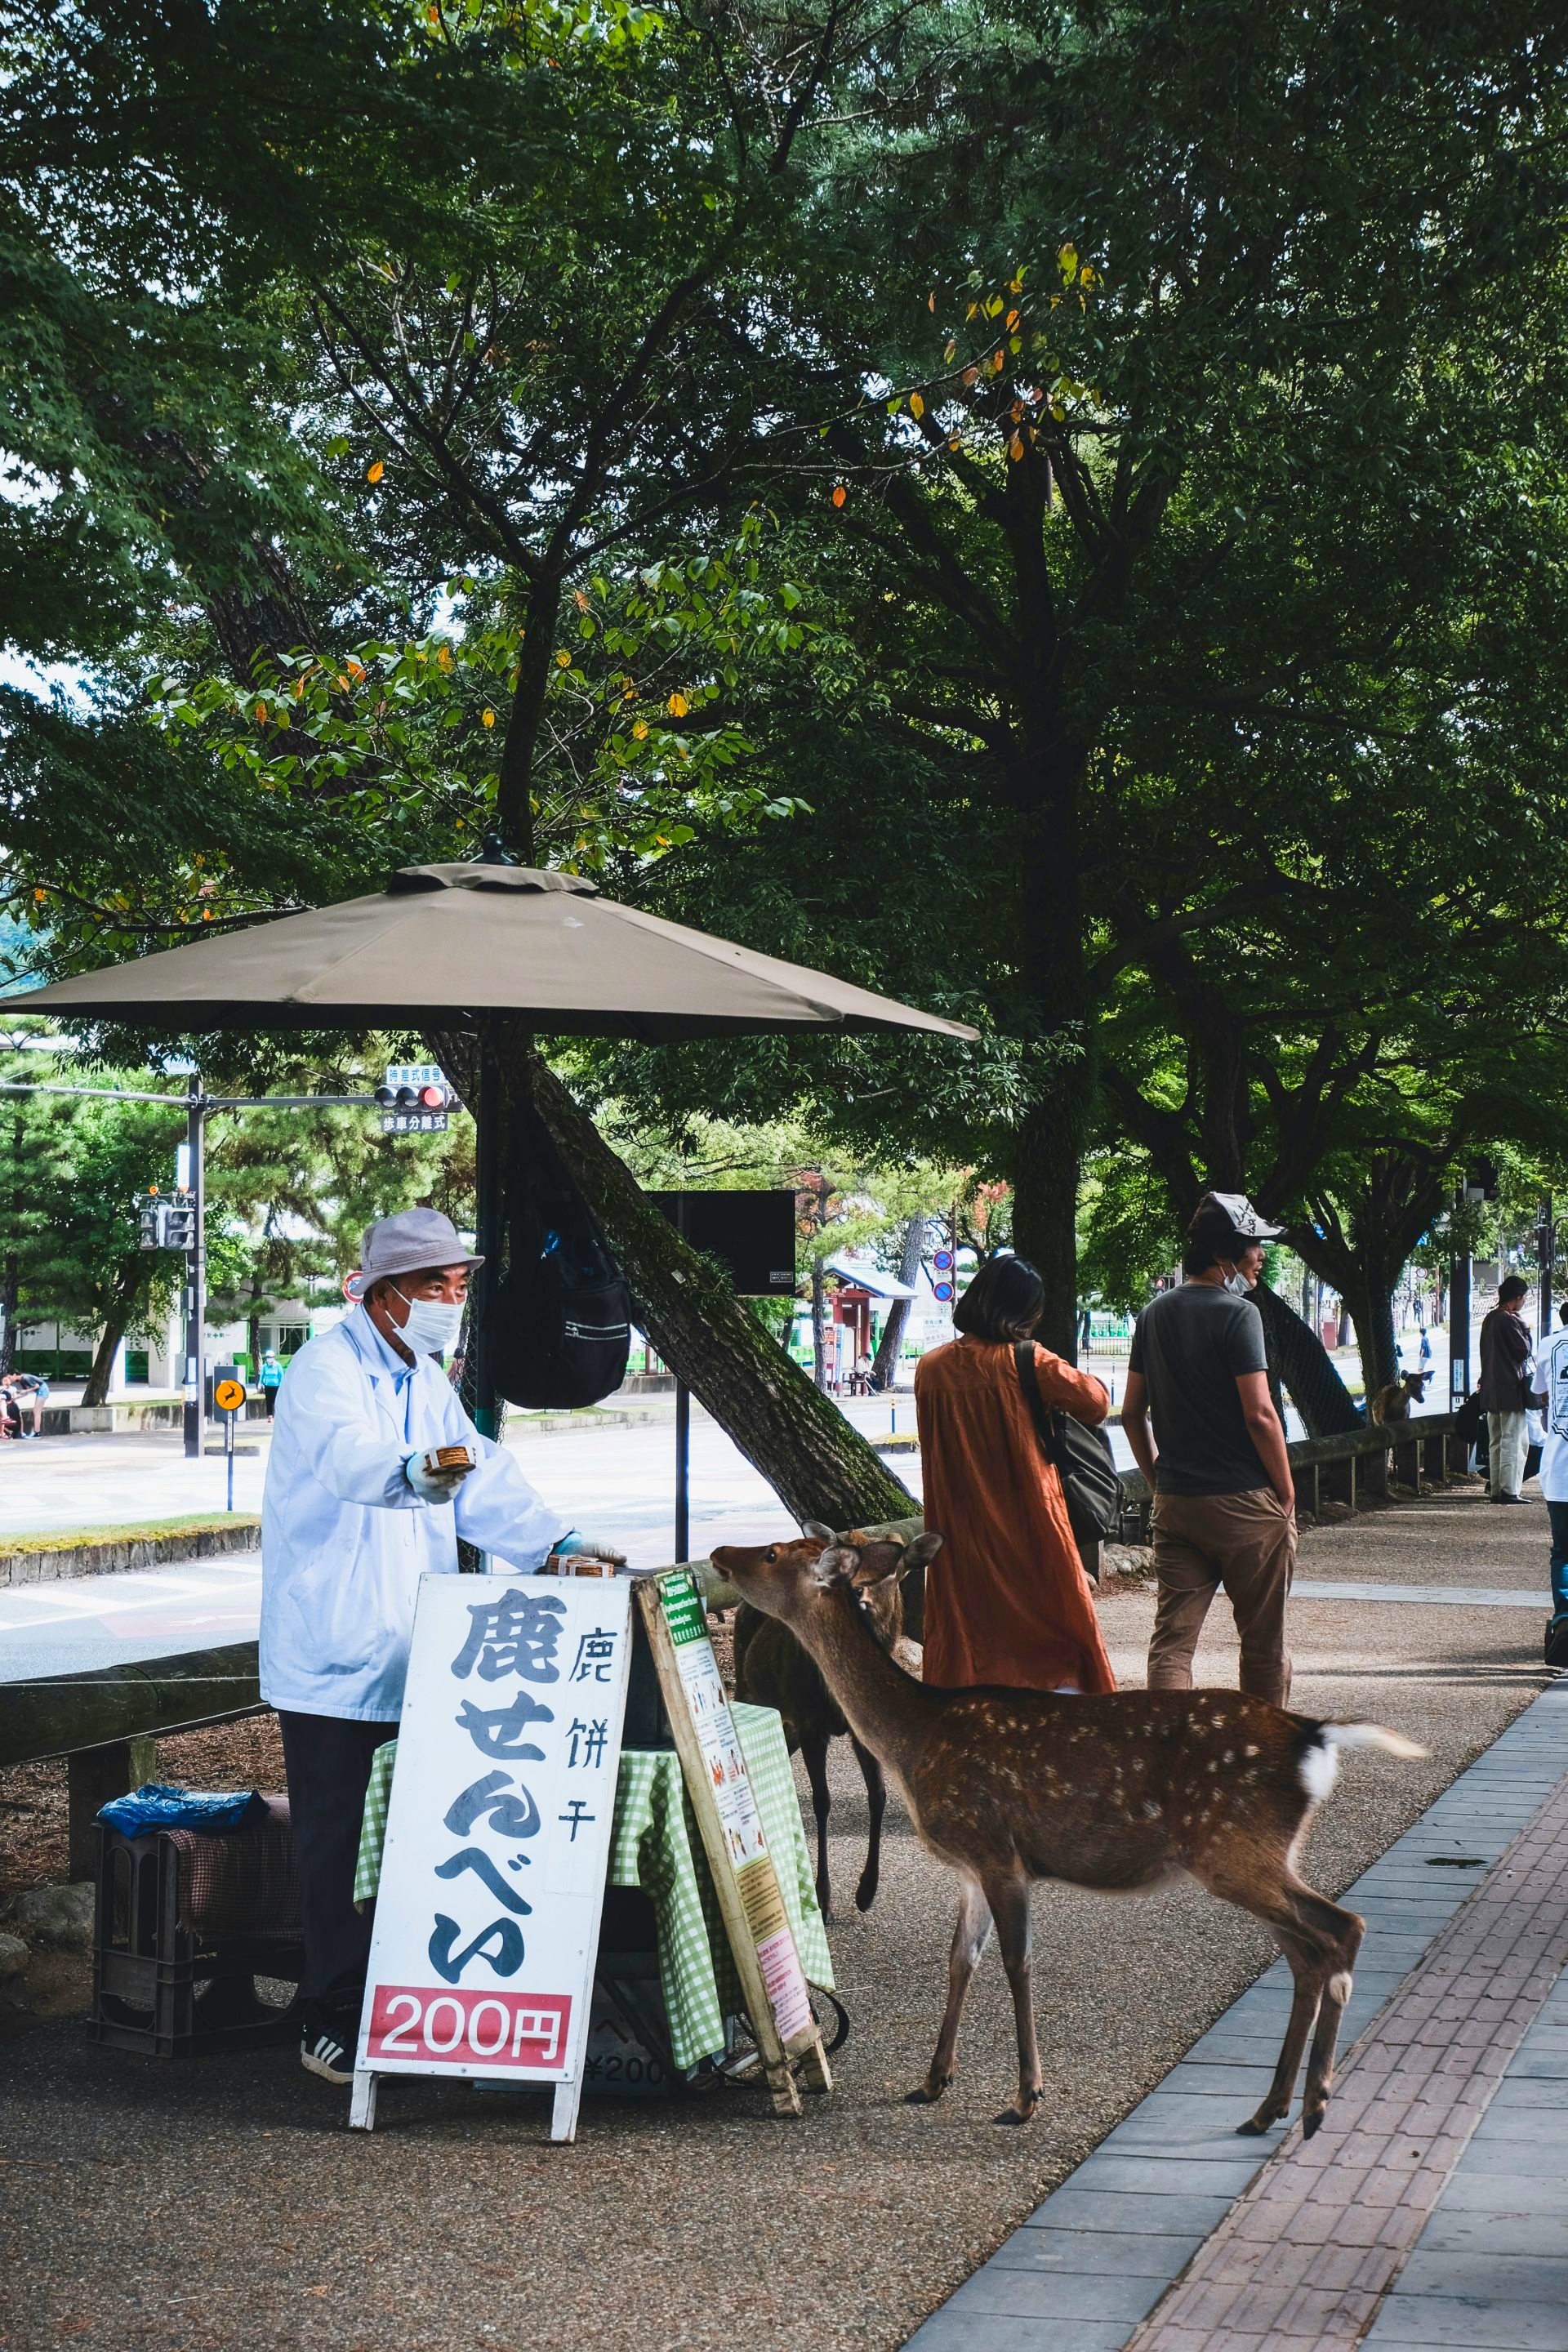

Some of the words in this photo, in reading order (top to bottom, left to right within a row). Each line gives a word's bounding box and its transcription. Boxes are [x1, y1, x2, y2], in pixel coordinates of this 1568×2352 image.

[390, 1068, 448, 1082] 時差式信号
[383, 1116, 446, 1130] 歩車分離式
[428, 1588, 568, 1984] 鹿せんべい
[379, 1996, 564, 2061] 200円
